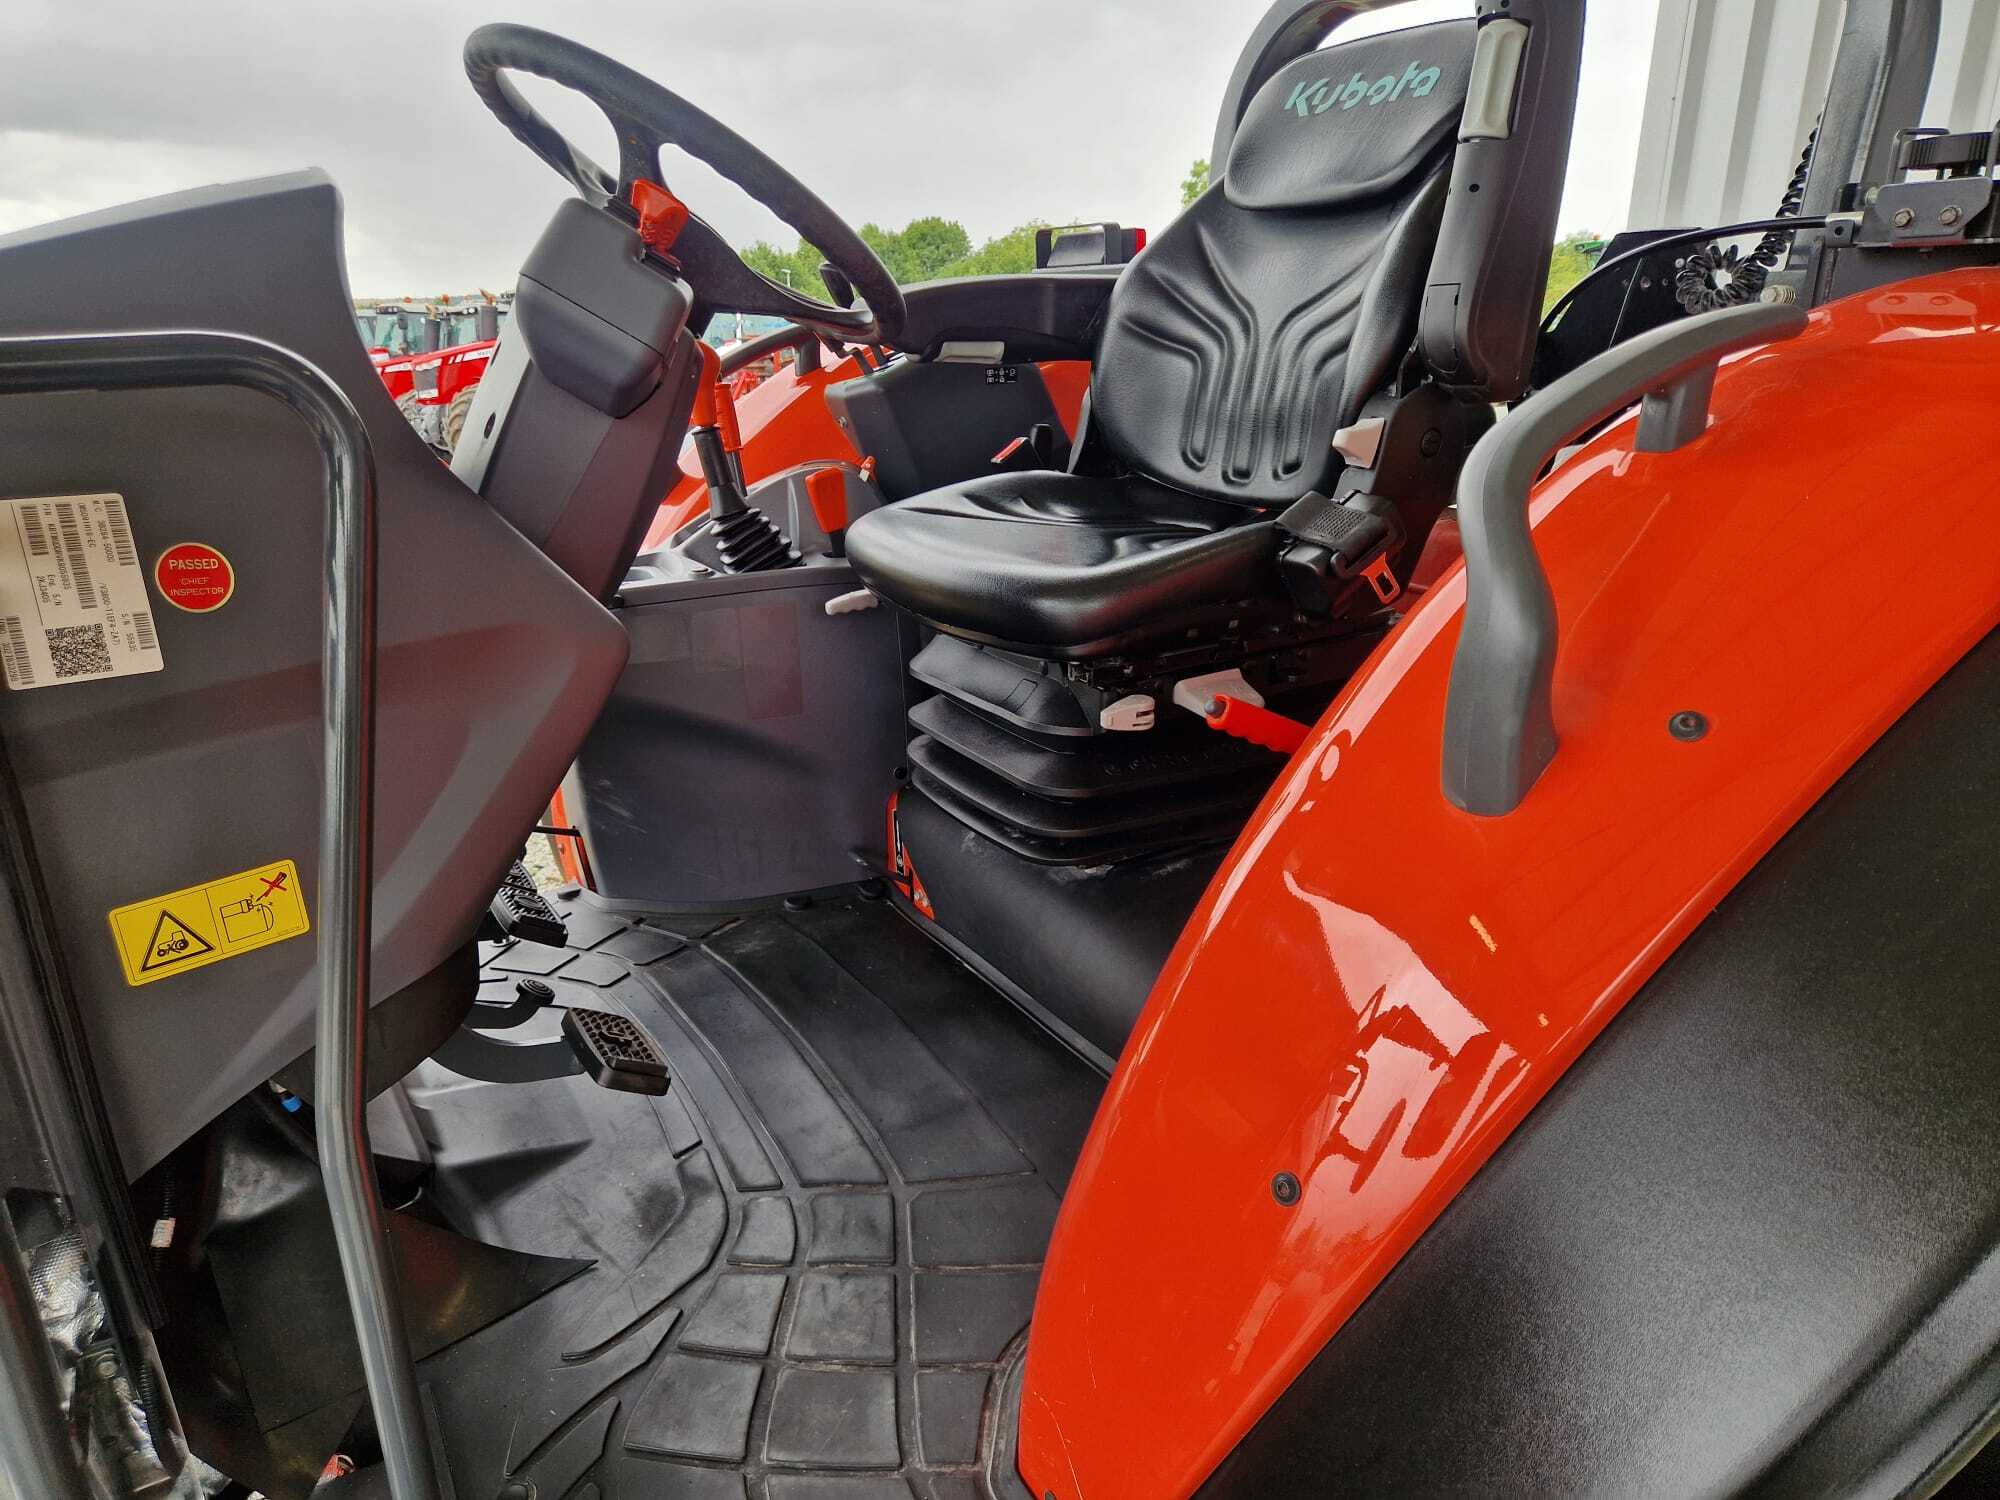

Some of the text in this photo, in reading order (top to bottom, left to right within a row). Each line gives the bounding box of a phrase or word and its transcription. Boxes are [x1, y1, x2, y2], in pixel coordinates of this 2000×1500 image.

[1284, 60, 1441, 117] Kubota
[169, 558, 219, 570] PASSED
[181, 576, 210, 586] CHIEF
[169, 586, 224, 597] INSPECTOR
